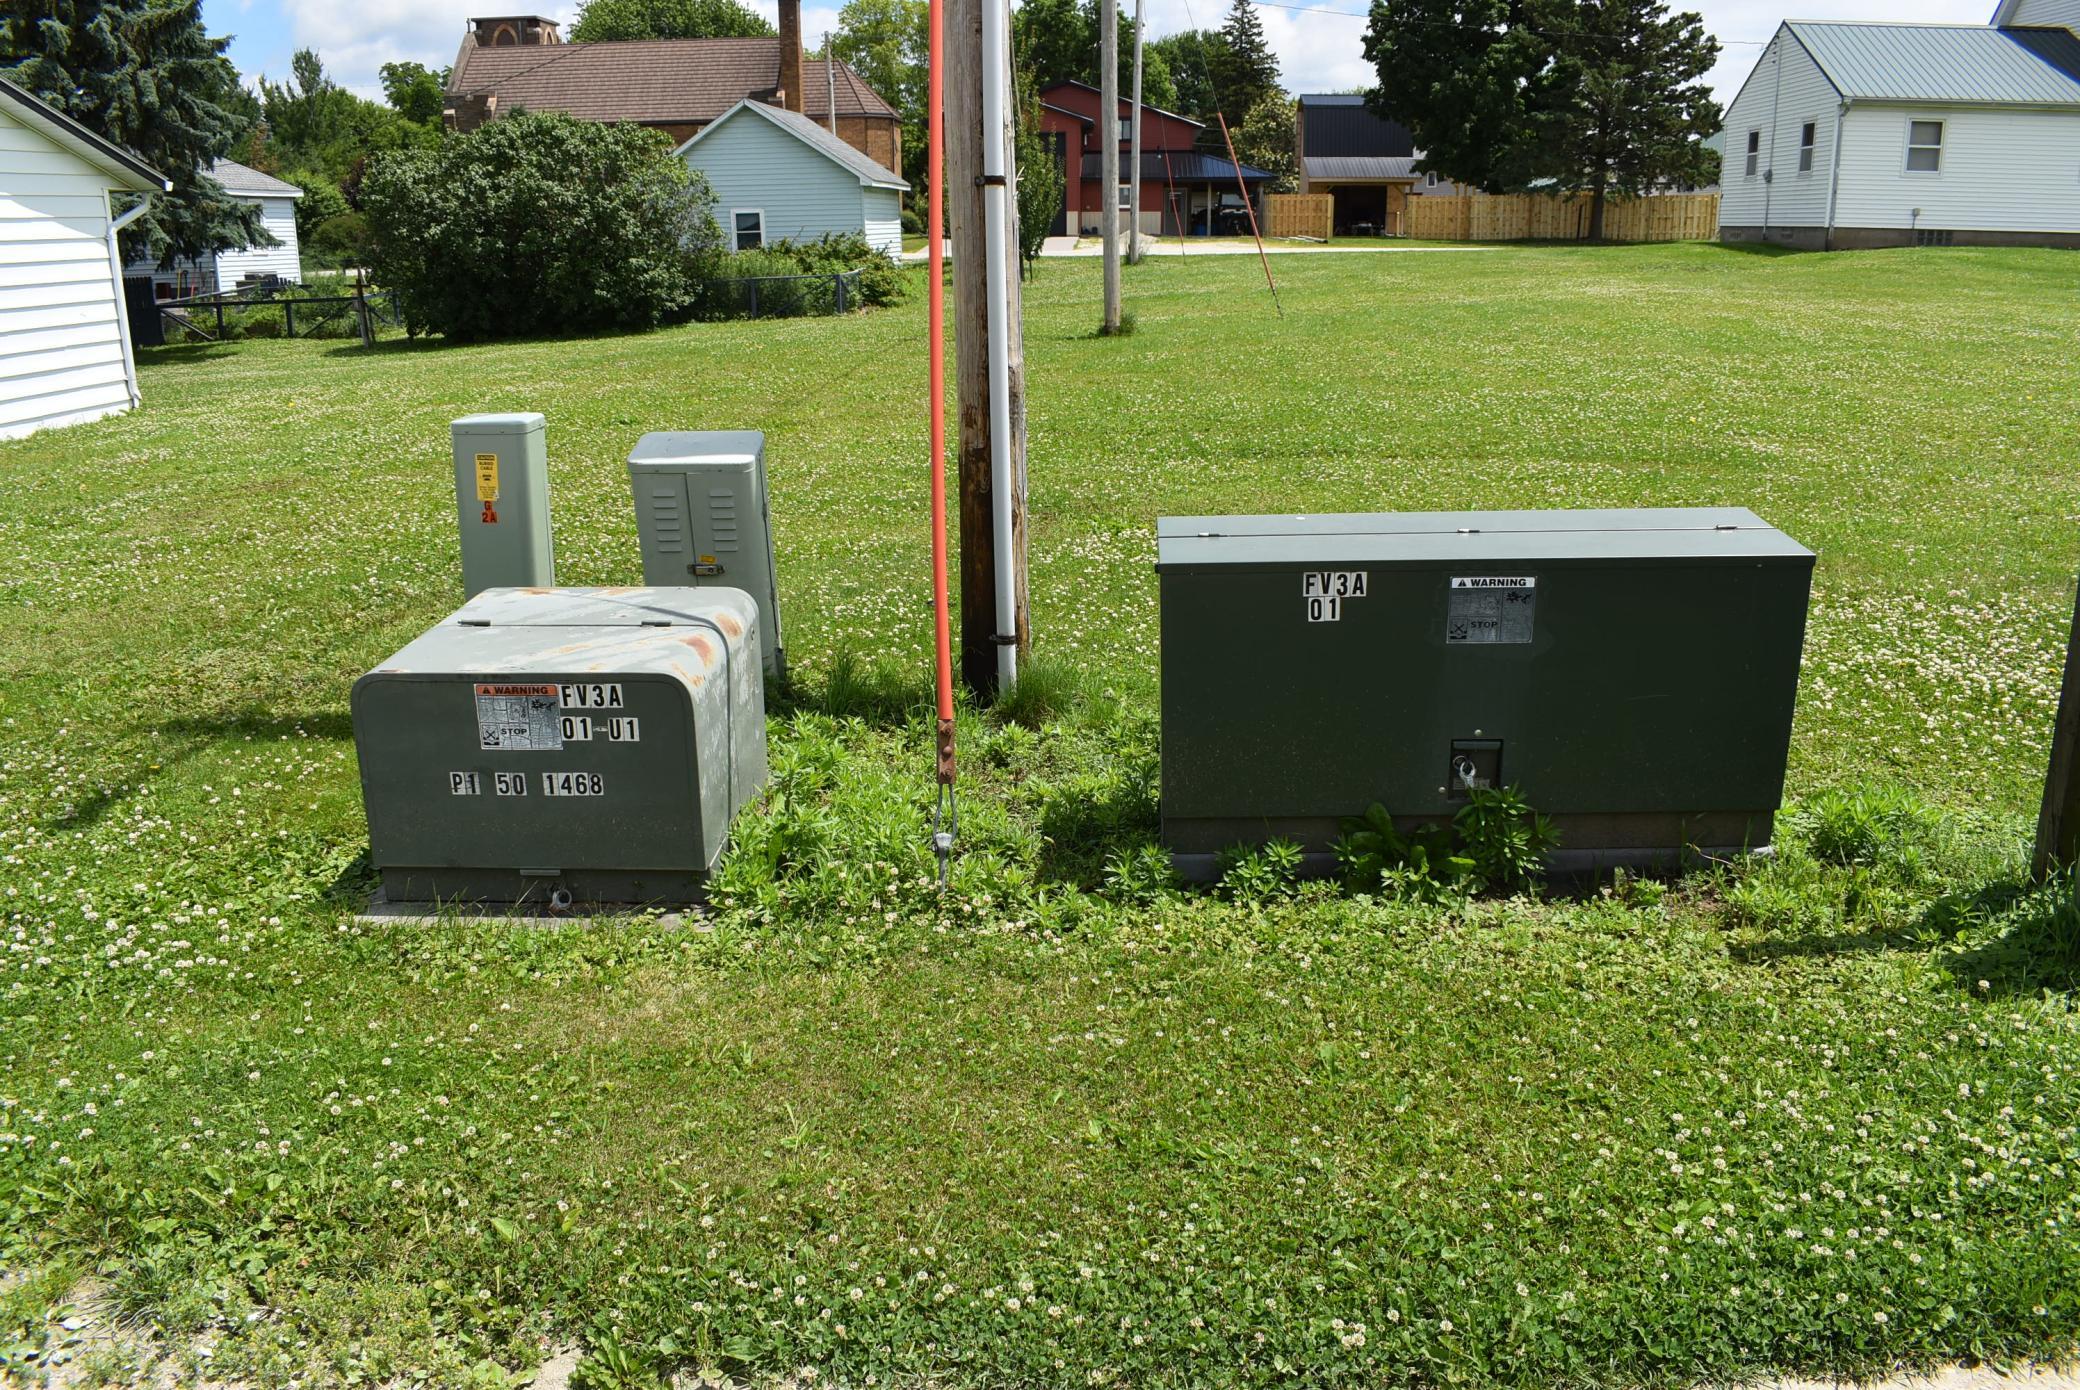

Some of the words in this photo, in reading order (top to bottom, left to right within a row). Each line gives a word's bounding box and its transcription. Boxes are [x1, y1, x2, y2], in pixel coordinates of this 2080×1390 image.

[482, 512, 498, 523] 2A
[1305, 572, 1365, 596] FV3A
[1470, 578, 1527, 587] WARNING
[1310, 598, 1337, 620] 01
[1471, 621, 1498, 629] STOP
[494, 686, 549, 695] WARNING
[561, 685, 622, 708] FV3A
[452, 773, 477, 794] P1
[497, 773, 525, 795] 50
[546, 773, 602, 795] 1468
